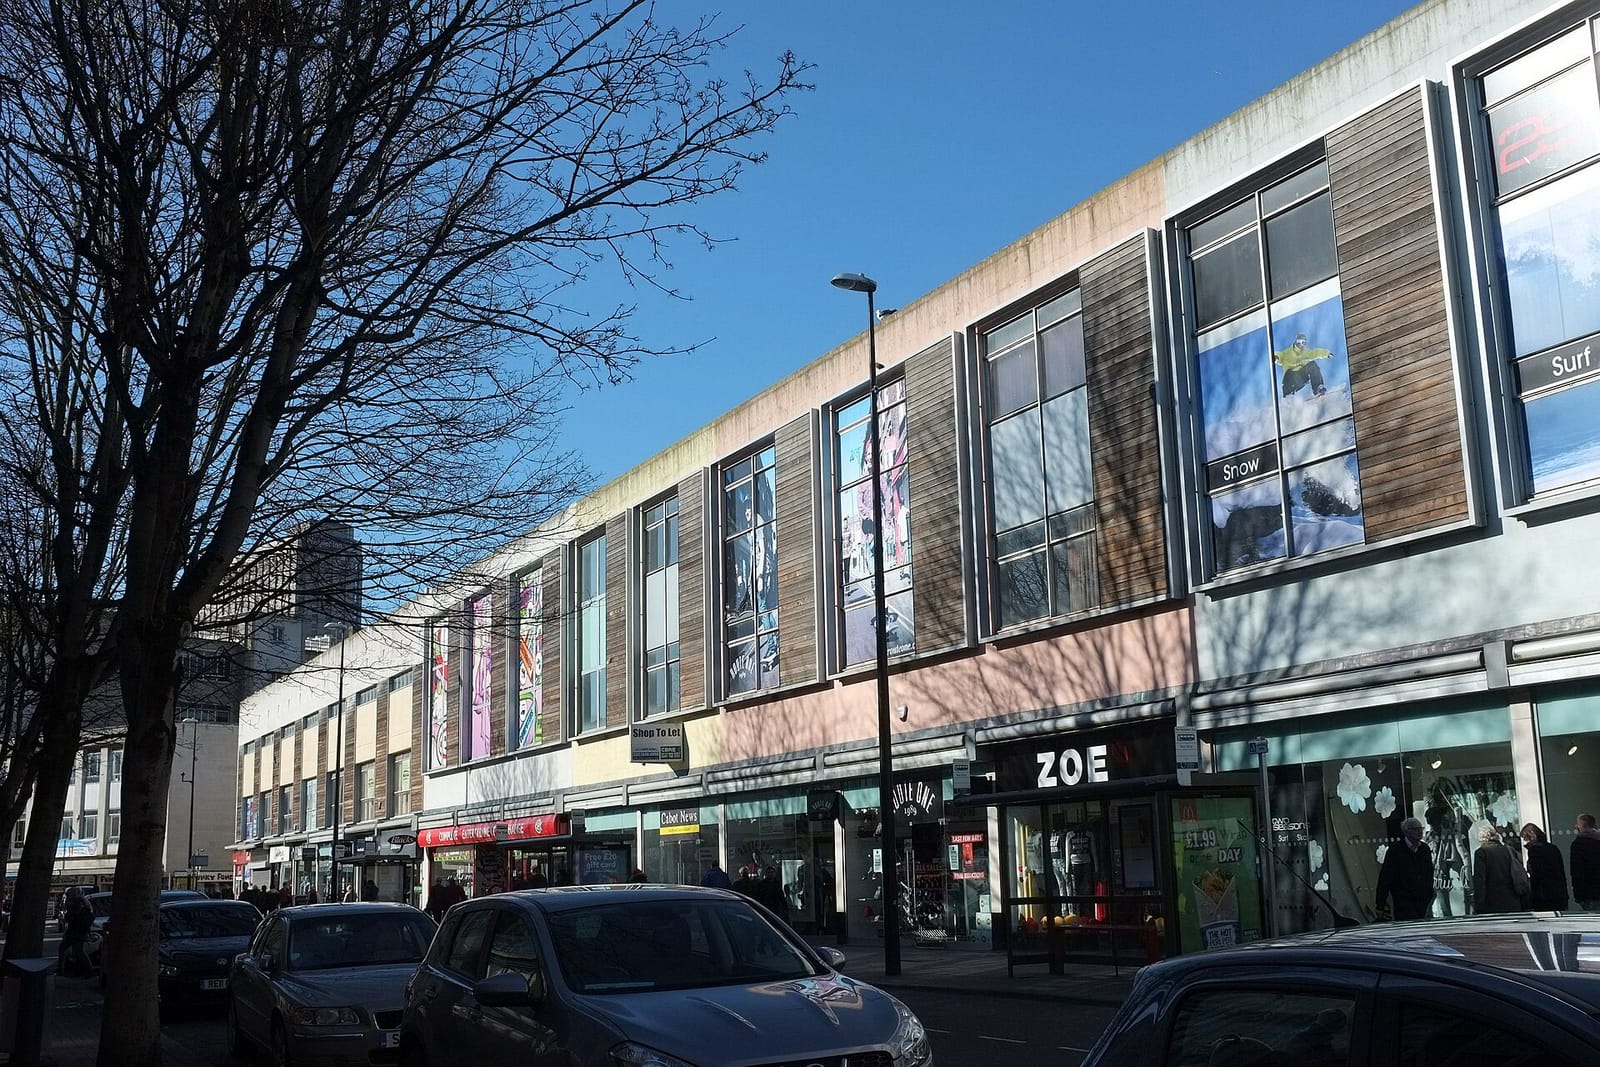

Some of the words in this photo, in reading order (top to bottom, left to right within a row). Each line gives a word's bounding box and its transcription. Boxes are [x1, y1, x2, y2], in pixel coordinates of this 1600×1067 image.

[1552, 345, 1591, 377] Surf
[1223, 457, 1260, 481] Snow
[633, 728, 655, 738] Shop
[656, 728, 666, 737] To
[667, 728, 680, 737] Let
[1037, 744, 1109, 788] ZOE
[893, 782, 913, 814] OUTE
[916, 781, 936, 814] ONE
[661, 811, 679, 825] Cabot
[680, 810, 698, 823] News
[1186, 829, 1216, 849] £1.99
[585, 853, 602, 861] Free
[1218, 848, 1241, 863] DAY
